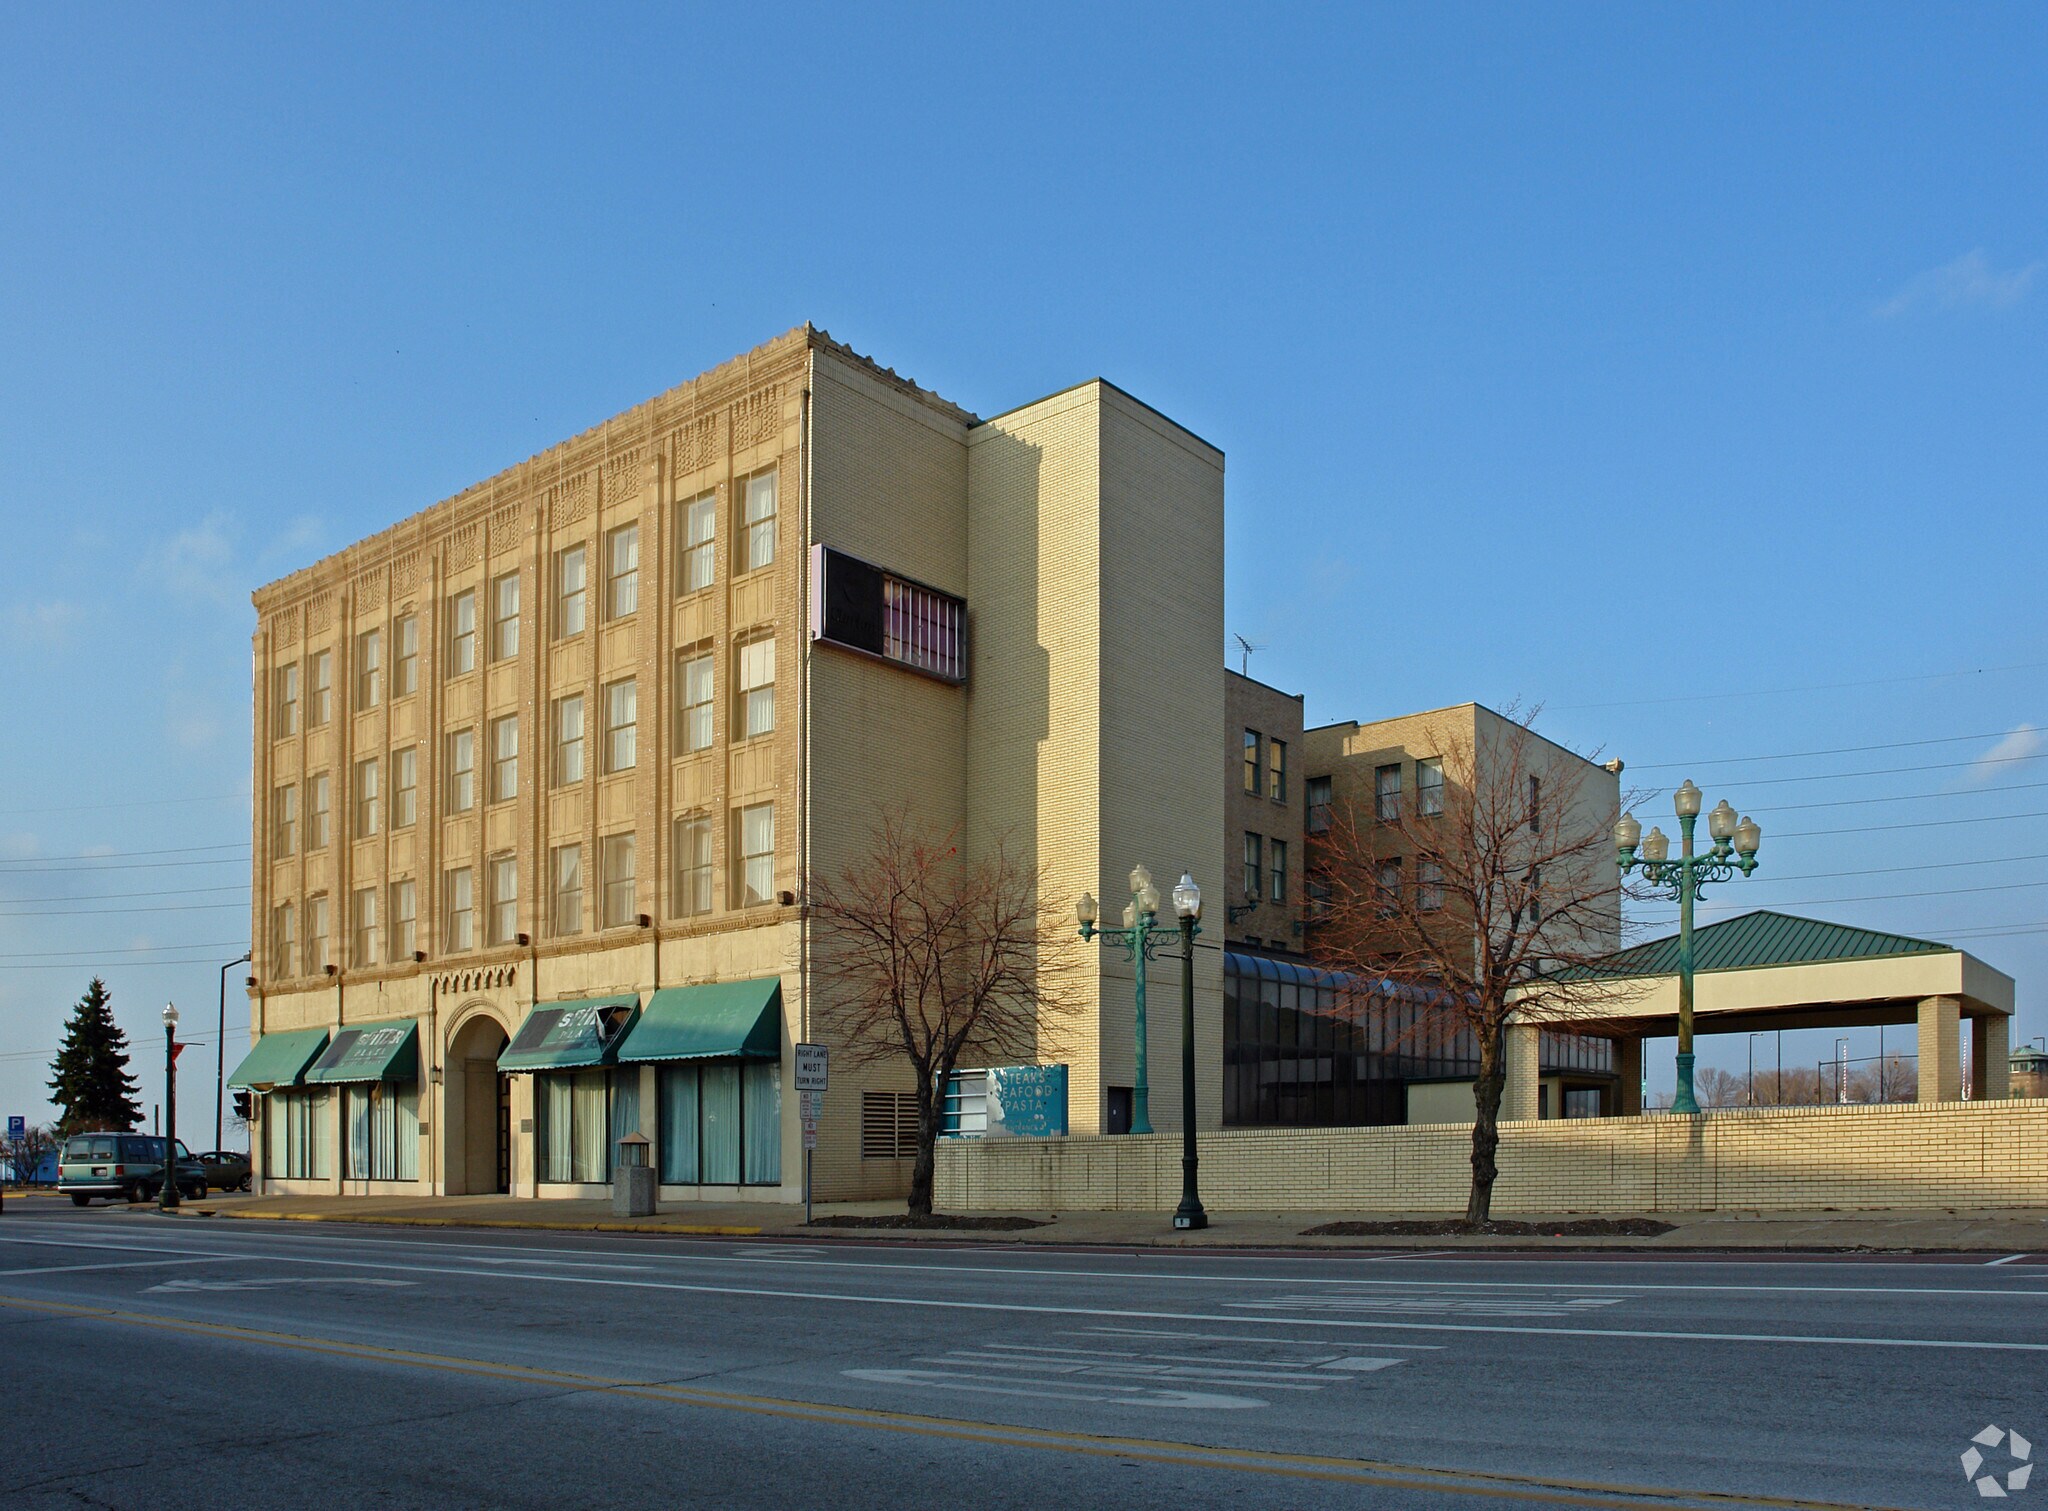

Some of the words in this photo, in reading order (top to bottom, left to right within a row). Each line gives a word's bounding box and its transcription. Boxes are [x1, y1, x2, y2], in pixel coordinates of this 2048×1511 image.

[798, 1050, 812, 1058] RIGHT
[813, 1051, 827, 1059] LANE
[803, 1063, 821, 1072] MUST
[797, 1076, 810, 1084] TURN
[811, 1077, 826, 1085] RIGHT
[1002, 1072, 1046, 1085] STEAKS
[1001, 1085, 1053, 1098] EAFOOD
[1005, 1100, 1043, 1112] PASTA
[11, 1118, 21, 1129] P
[840, 1326, 1450, 1408] ONLY
